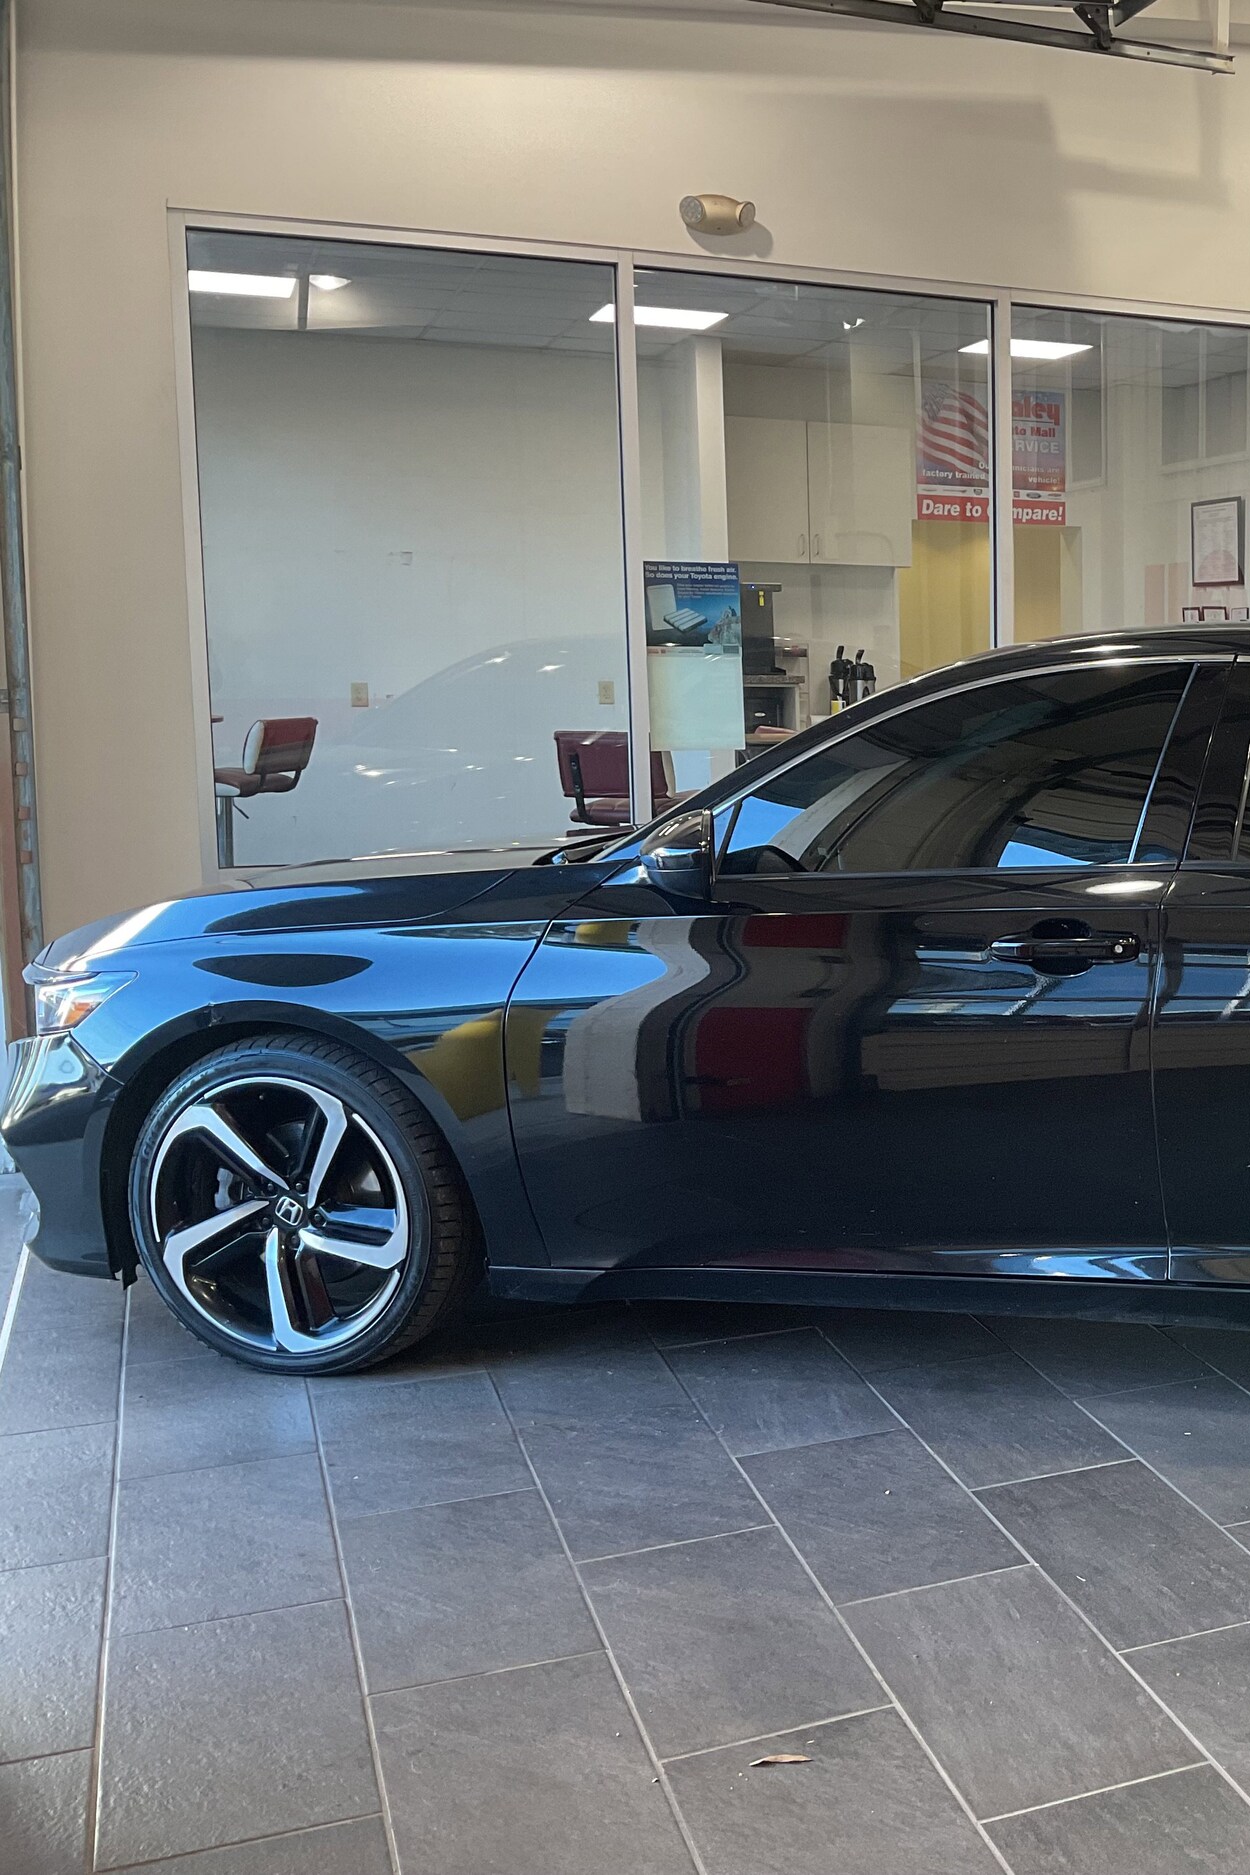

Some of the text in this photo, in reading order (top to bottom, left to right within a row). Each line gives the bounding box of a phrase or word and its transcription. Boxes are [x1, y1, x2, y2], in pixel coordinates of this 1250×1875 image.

[1012, 396, 1060, 426] aley
[1014, 440, 1060, 454] RVICE
[923, 469, 953, 480] factory
[955, 471, 986, 480] trained
[921, 499, 960, 517] Dare
[965, 501, 982, 518] to
[681, 565, 707, 573] breathe
[690, 573, 712, 581] Toyota
[713, 573, 738, 581] engine.
